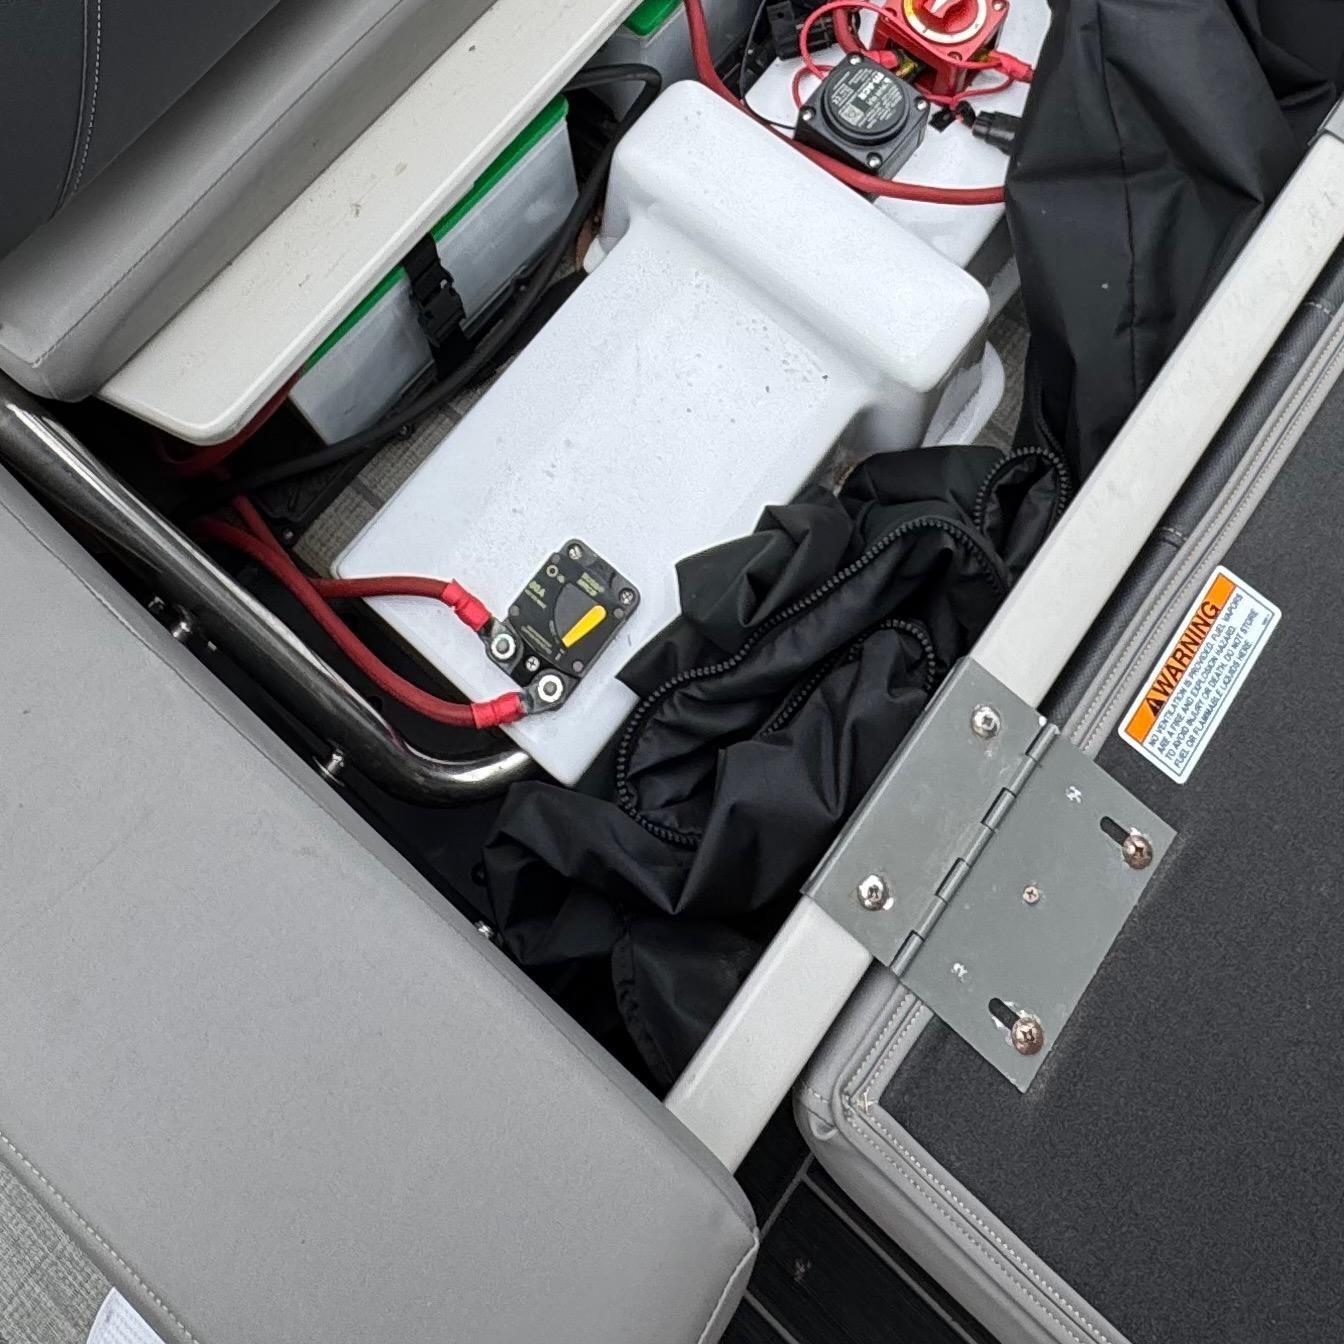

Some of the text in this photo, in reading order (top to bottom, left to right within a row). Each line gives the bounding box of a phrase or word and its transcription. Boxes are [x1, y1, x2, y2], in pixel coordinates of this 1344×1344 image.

[1148, 733, 1159, 747] NO
[1155, 687, 1187, 734] VENTILATION
[1183, 679, 1192, 688] IS
[1211, 624, 1226, 641] FUEL
[1222, 593, 1243, 622] VAPORS
[1151, 601, 1220, 697] WARNING
[1165, 748, 1176, 760] TO
[1172, 725, 1190, 750] AVOID
[1185, 698, 1204, 727] INJURY
[1201, 686, 1212, 700] OR
[1223, 649, 1235, 662] DO
[1231, 632, 1244, 650] NOT
[1240, 608, 1258, 634] STORE
[1190, 655, 1219, 698] EXPLOSION
[1170, 712, 1185, 731] FIRE
[1174, 748, 1190, 769] FUEL
[1185, 734, 1197, 748] OR
[1192, 688, 1223, 736] FLAMMABLE
[1220, 660, 1240, 691] LIQUIDS
[1181, 696, 1194, 714] AND
[1157, 736, 1171, 755] ARE
[1166, 730, 1175, 738] A
